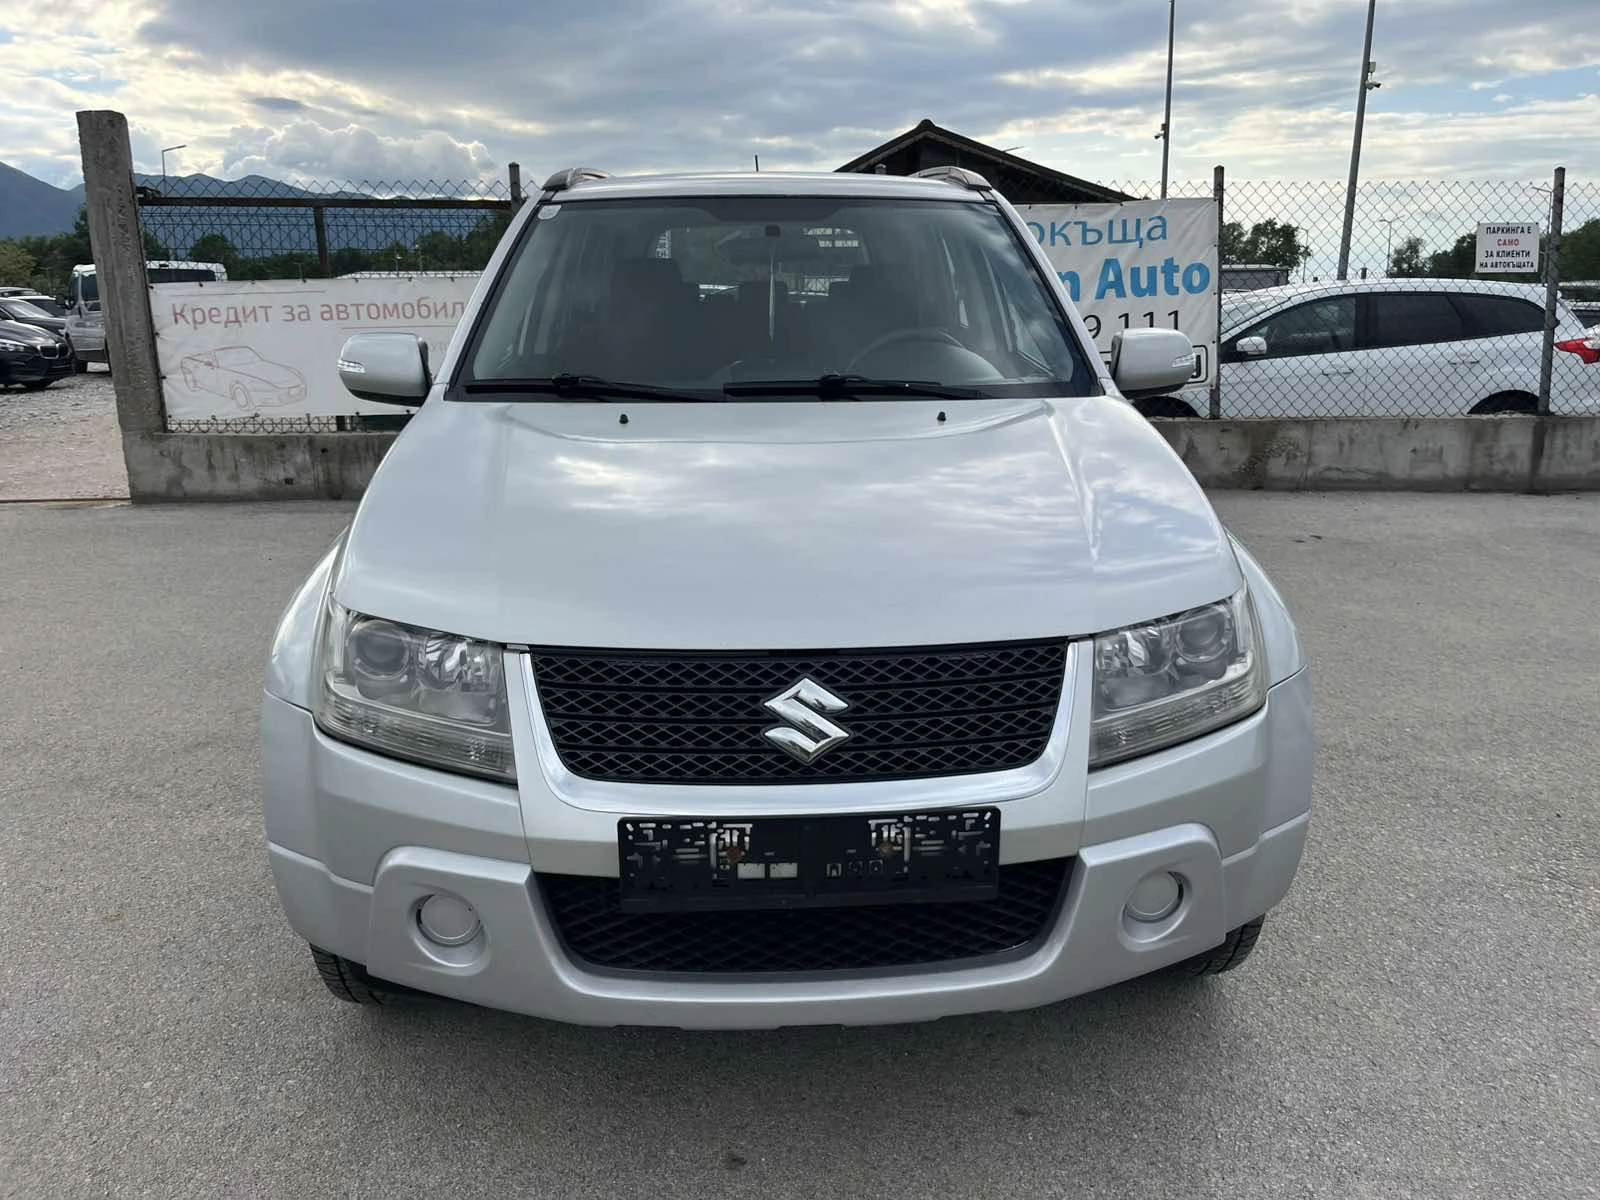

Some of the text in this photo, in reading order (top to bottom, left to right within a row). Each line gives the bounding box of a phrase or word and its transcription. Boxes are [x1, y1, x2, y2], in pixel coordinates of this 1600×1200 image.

[1486, 226, 1532, 234] ПАРКИНГА Е
[1485, 250, 1530, 258] ЗА КЛИЕНТИ
[1490, 261, 1534, 269] АВТОКЪЩАТА
[1095, 256, 1210, 300] Auto
[172, 296, 464, 329] Кредит за автомобил
